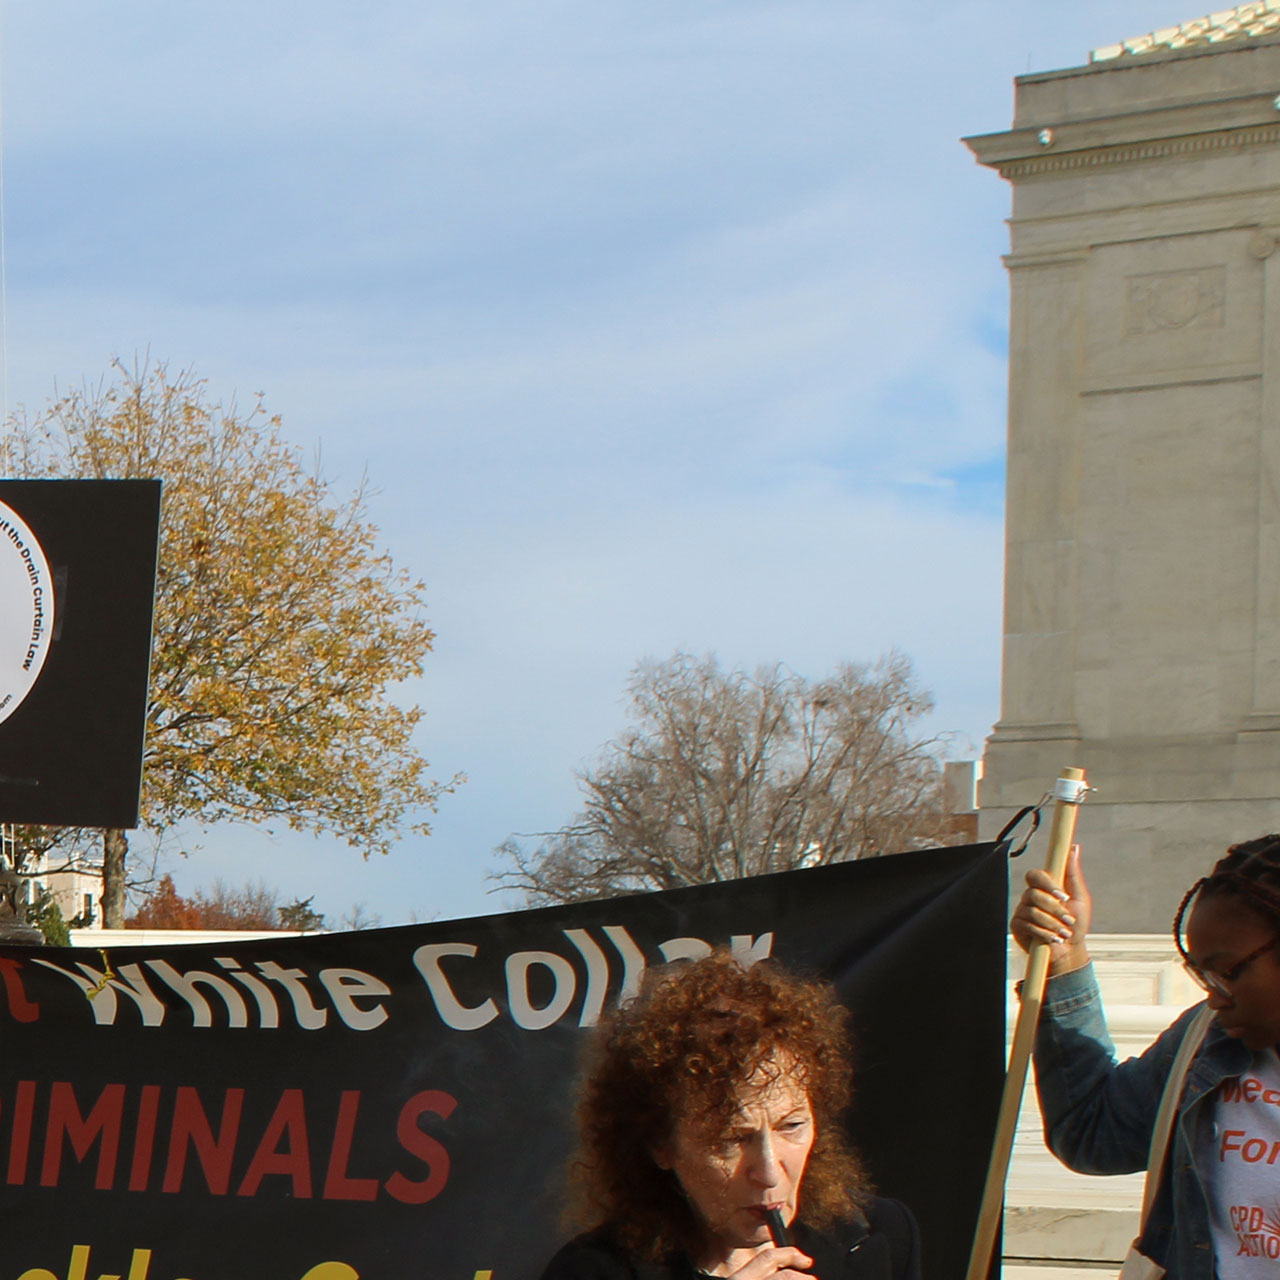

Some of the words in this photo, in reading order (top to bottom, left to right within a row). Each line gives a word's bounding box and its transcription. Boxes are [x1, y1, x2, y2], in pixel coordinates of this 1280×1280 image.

[7, 527, 24, 550] the
[20, 547, 41, 586] Drain
[31, 587, 45, 642] Curtain
[22, 643, 40, 672] Law
[30, 956, 391, 1031] White
[1230, 1206, 1264, 1232] CPD
